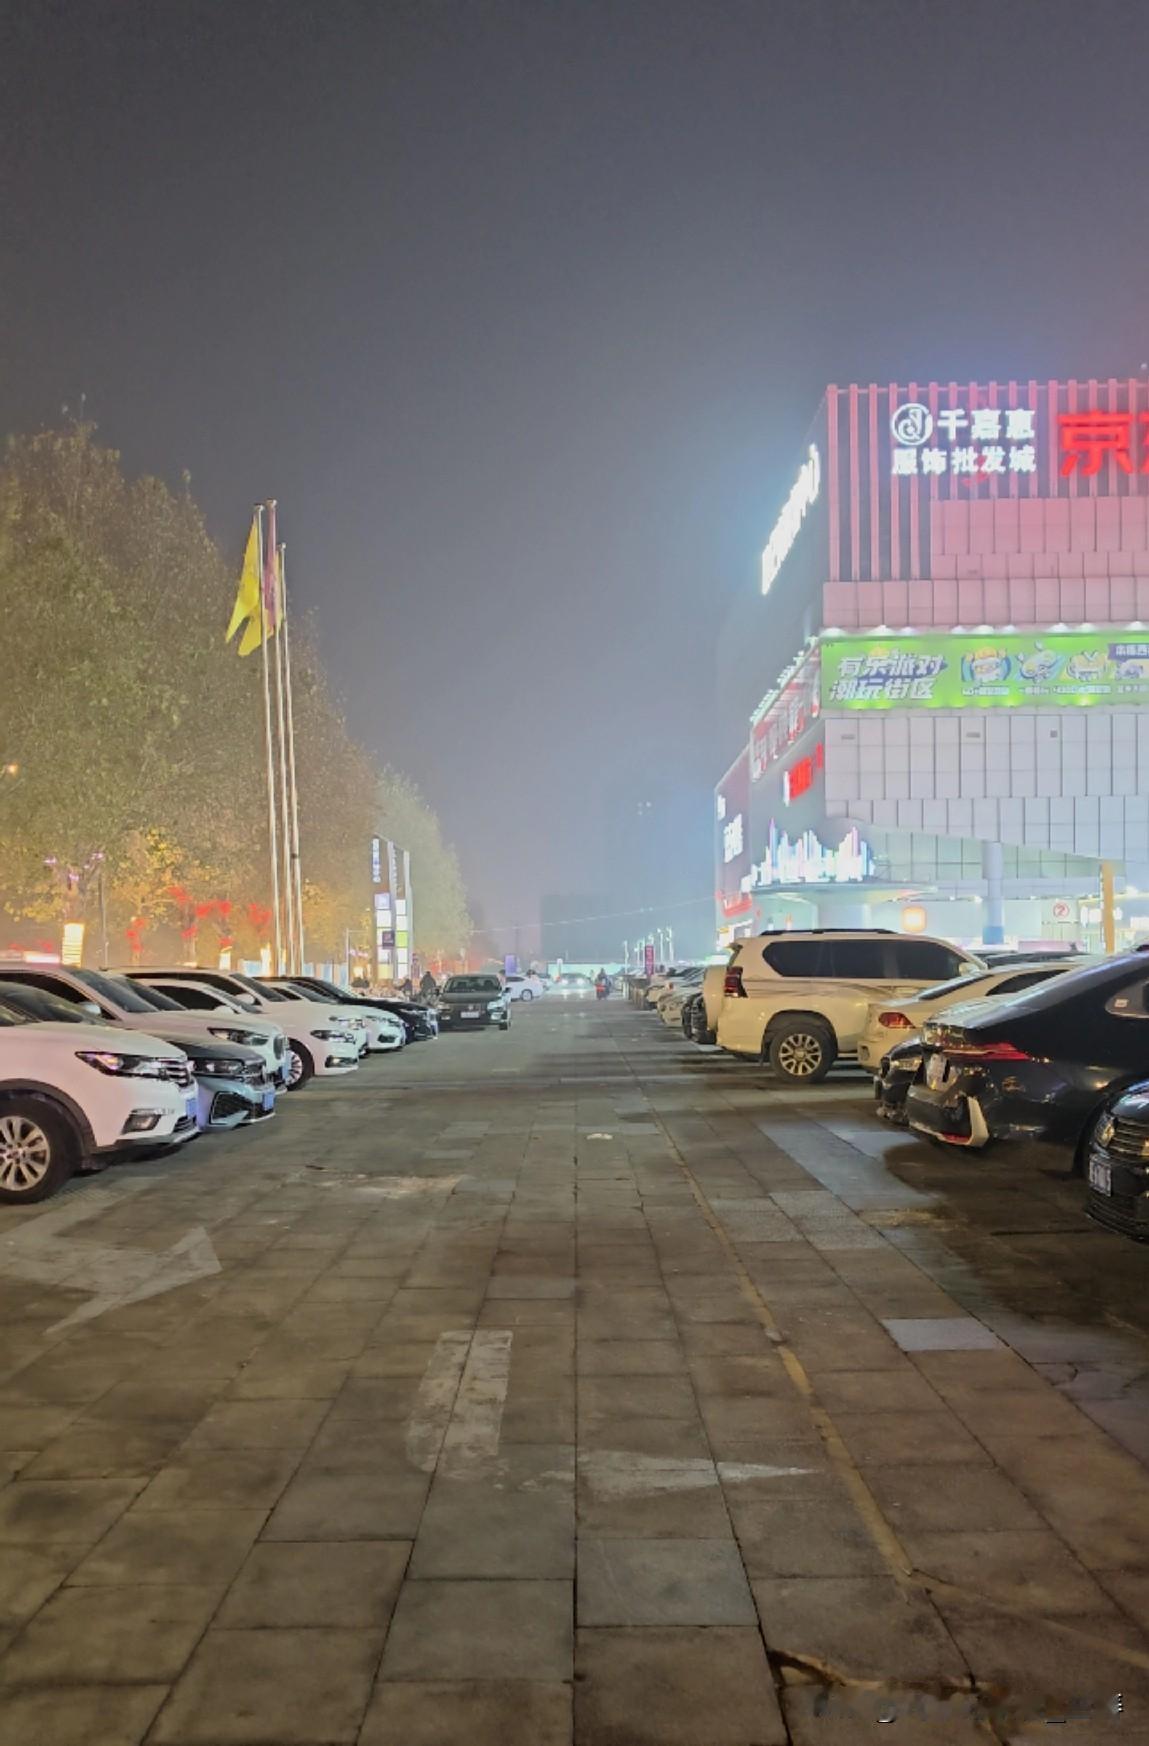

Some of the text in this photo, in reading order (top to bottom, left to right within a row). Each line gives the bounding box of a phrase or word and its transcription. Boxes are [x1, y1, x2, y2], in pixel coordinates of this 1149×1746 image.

[891, 446, 1037, 475] 服饰批发城
[1058, 410, 1149, 477] 京
